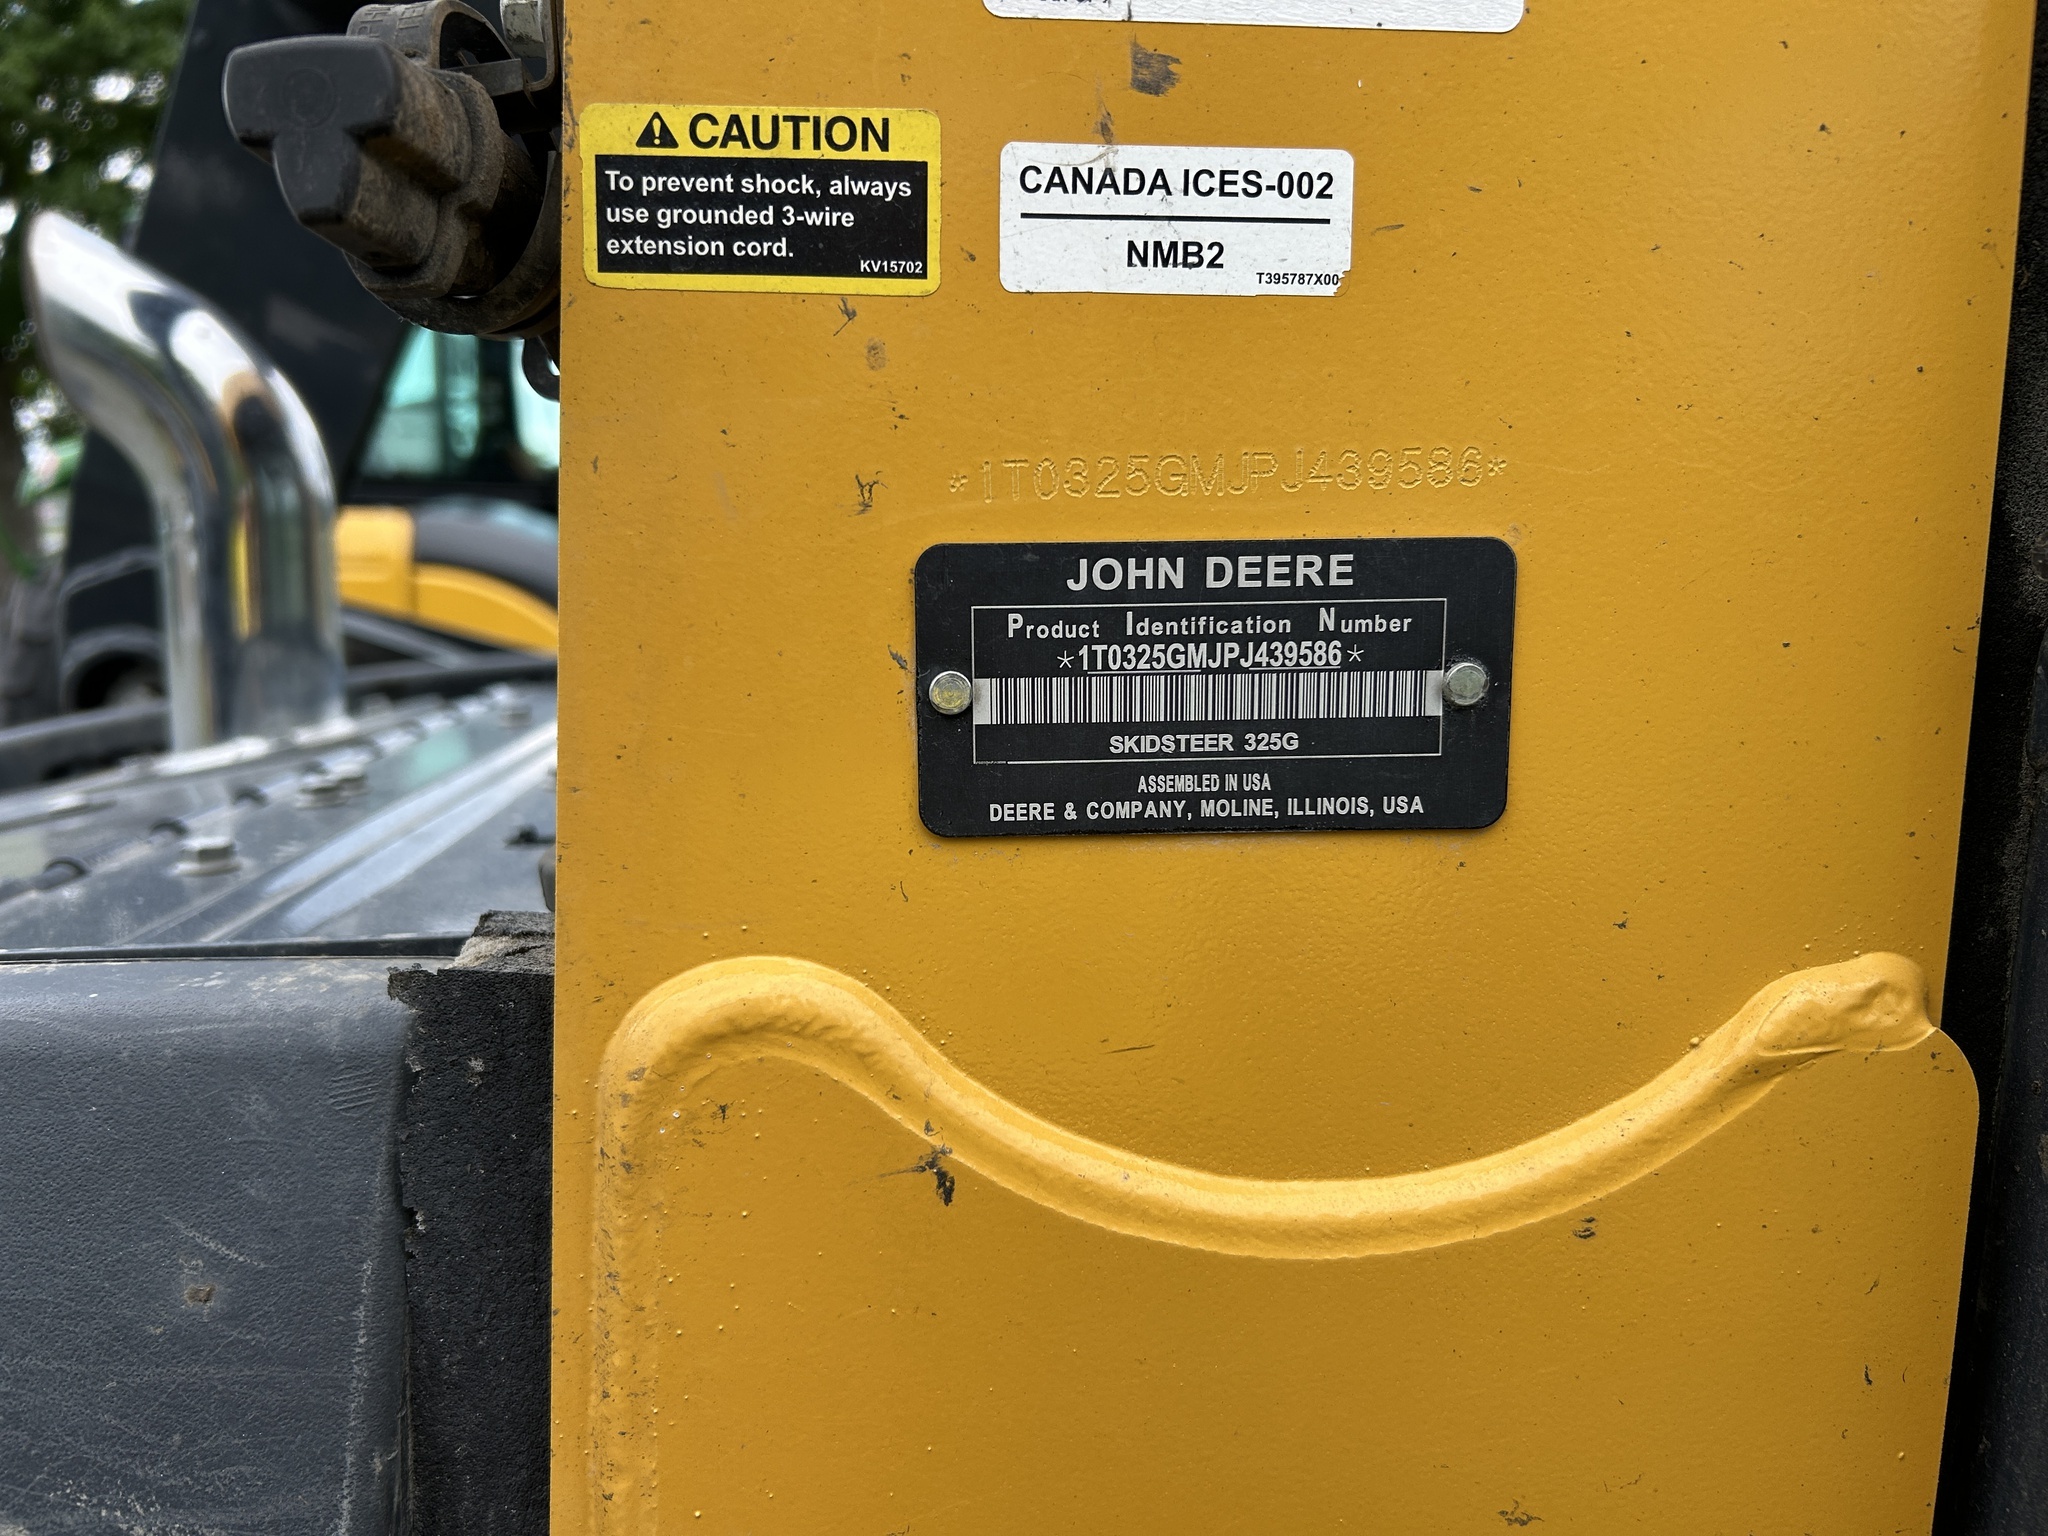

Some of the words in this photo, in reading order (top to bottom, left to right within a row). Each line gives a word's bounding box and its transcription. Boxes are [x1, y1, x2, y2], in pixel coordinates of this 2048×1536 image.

[688, 112, 890, 153] CAUTION
[604, 170, 634, 192] To
[642, 173, 734, 197] prevent
[741, 173, 821, 199] shock,
[829, 175, 912, 202] always
[1019, 165, 1173, 197] CANADA
[1182, 168, 1334, 200] ICES-002
[606, 207, 649, 224] use
[656, 204, 774, 229] grounded
[781, 205, 855, 228] 3-wire
[606, 235, 725, 256] extension
[732, 236, 794, 258] cord.
[1126, 240, 1225, 270] NMB2
[860, 259, 923, 274] KV15702
[1255, 272, 1340, 286] T395787X00
[1066, 556, 1184, 591] JOHN
[1205, 553, 1354, 589] DEERE
[1007, 613, 1100, 639] Product
[1126, 611, 1292, 636] Identification
[1318, 606, 1413, 634] Number
[1109, 733, 1235, 754] SKIDSTEER
[1243, 731, 1299, 752] 325G
[1137, 773, 1220, 794] ASSEMBLED
[1224, 773, 1238, 792] IN
[1242, 772, 1272, 792] USA
[989, 802, 1055, 822] DEERE
[1063, 801, 1078, 821] &
[1086, 799, 1192, 821] COMPANY,
[1200, 798, 1279, 819] MOLINE,
[1287, 796, 1375, 818] ILLINOIS,
[1382, 795, 1424, 815] USA
